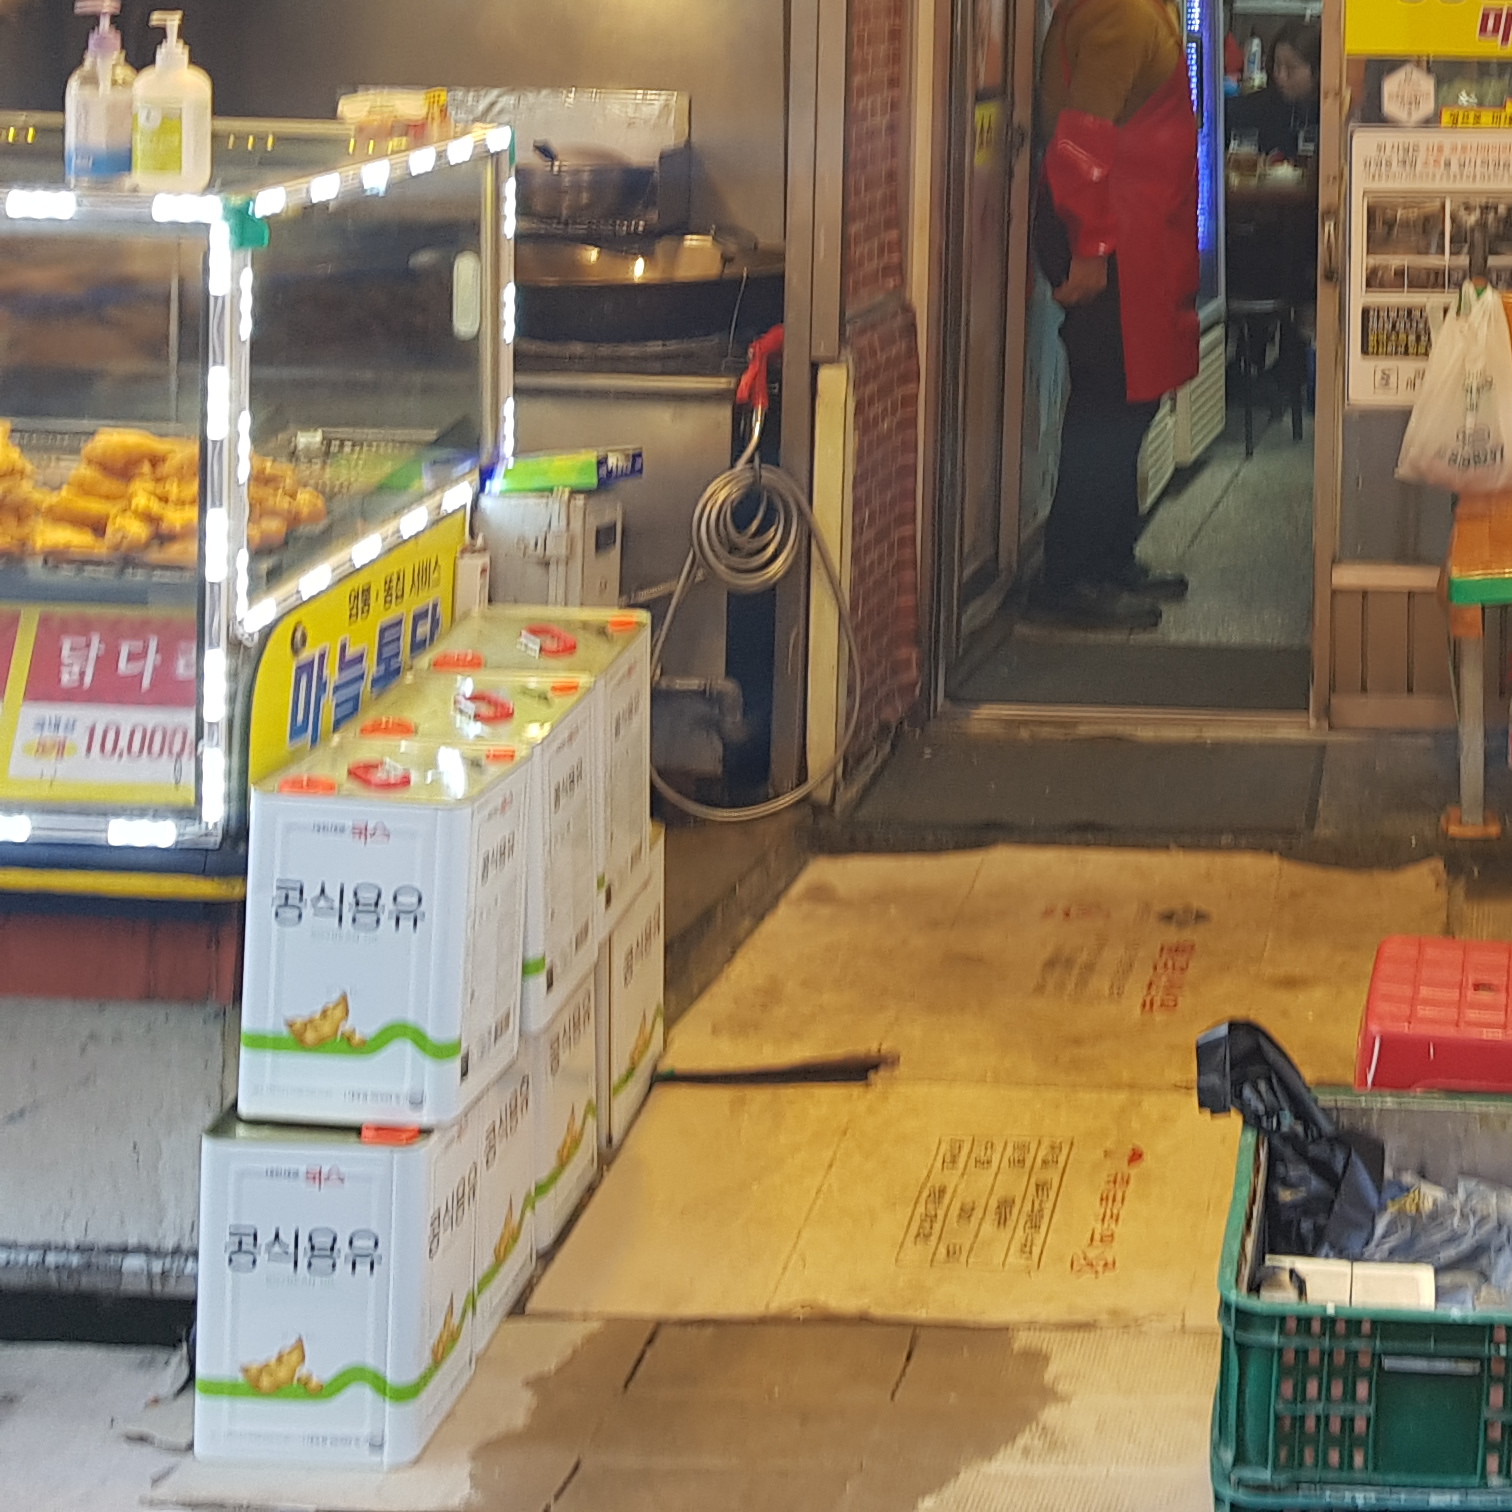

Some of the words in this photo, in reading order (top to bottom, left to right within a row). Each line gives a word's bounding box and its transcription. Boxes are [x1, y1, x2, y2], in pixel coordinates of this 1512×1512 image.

[409, 554, 441, 598] 서비스
[85, 720, 196, 762] 10,000
[271, 877, 426, 934] 콩식용유
[225, 1223, 382, 1278] 콩식용유
